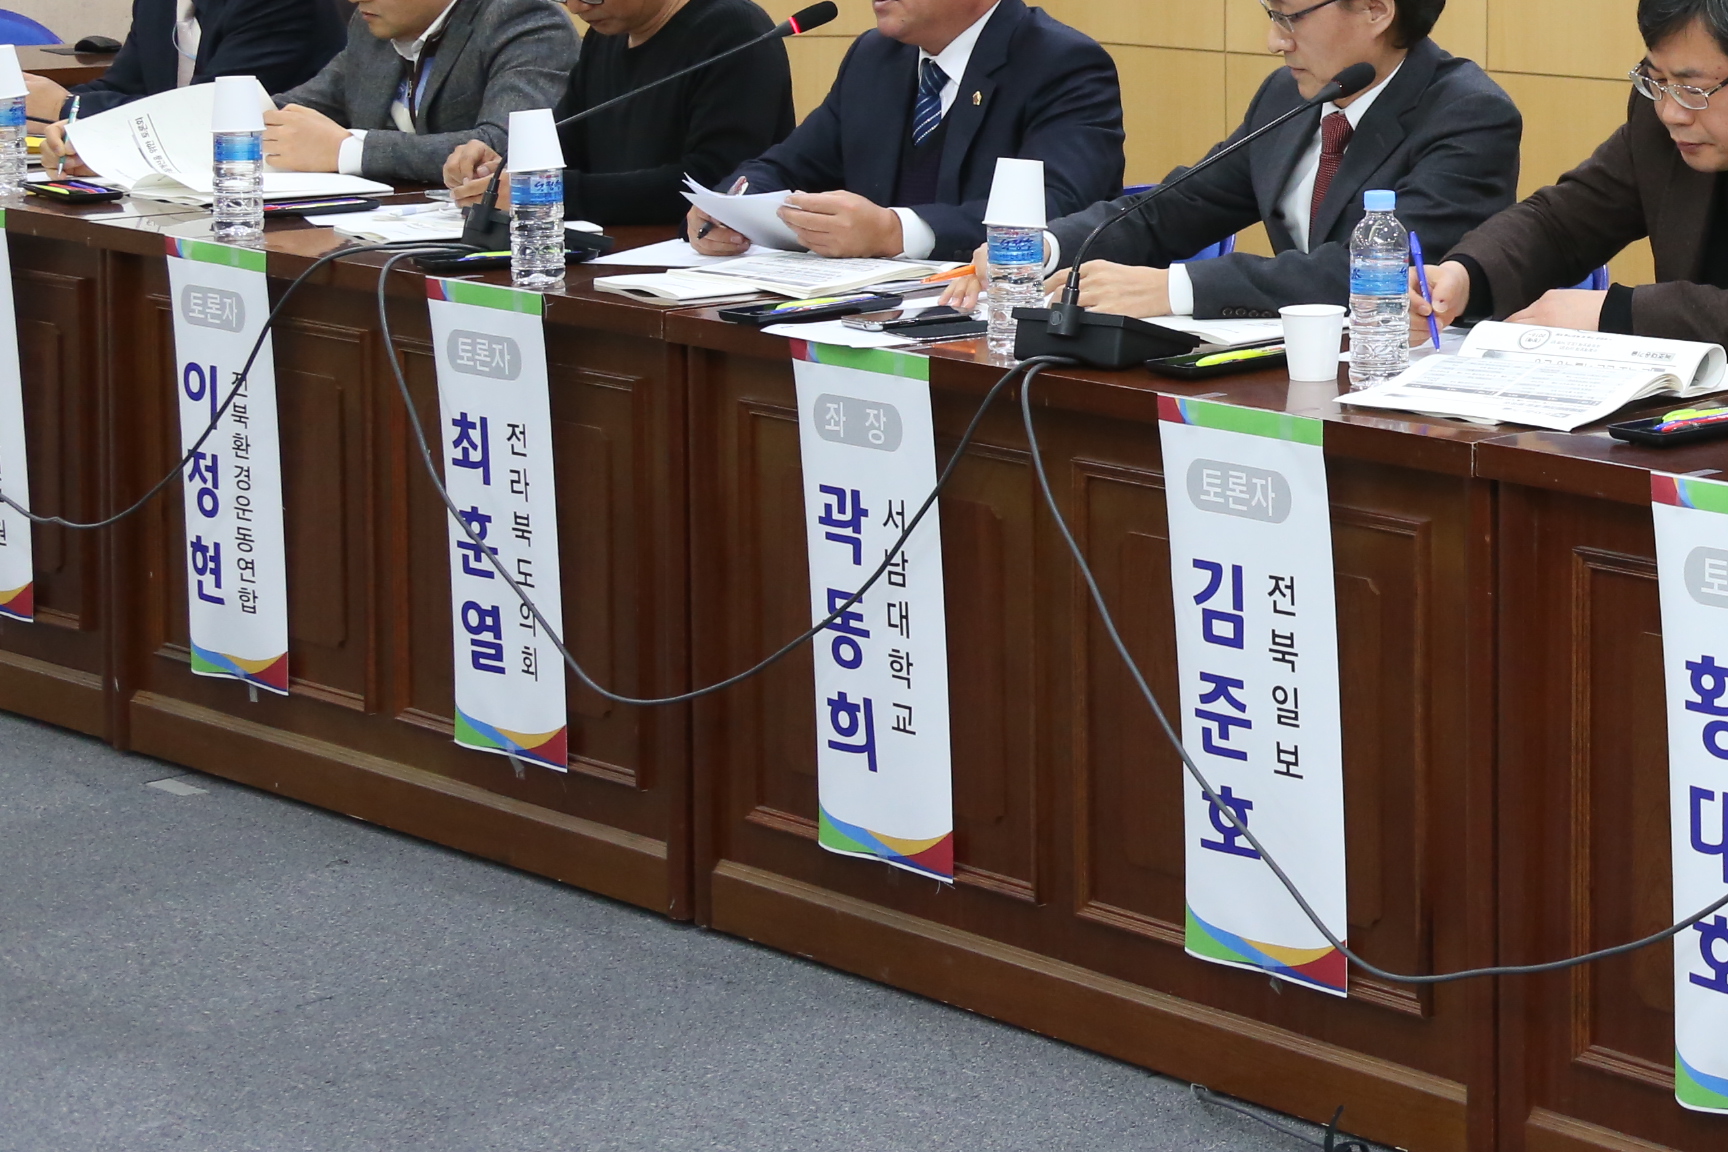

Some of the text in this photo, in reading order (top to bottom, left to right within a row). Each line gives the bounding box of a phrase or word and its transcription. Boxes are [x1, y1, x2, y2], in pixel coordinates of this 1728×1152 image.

[189, 292, 237, 328] 토론자
[456, 337, 511, 375] 토론자
[183, 361, 226, 606] 이정현
[231, 371, 259, 615] 전북환경운동연합
[451, 411, 507, 676] 최훈열
[506, 422, 539, 682] 전라북도의회
[1200, 468, 1276, 517] 토론자
[818, 483, 878, 773] 곽동희
[882, 499, 917, 736] 서남대학교
[1192, 557, 1263, 861] 김준호
[1267, 574, 1304, 780] 전북일보
